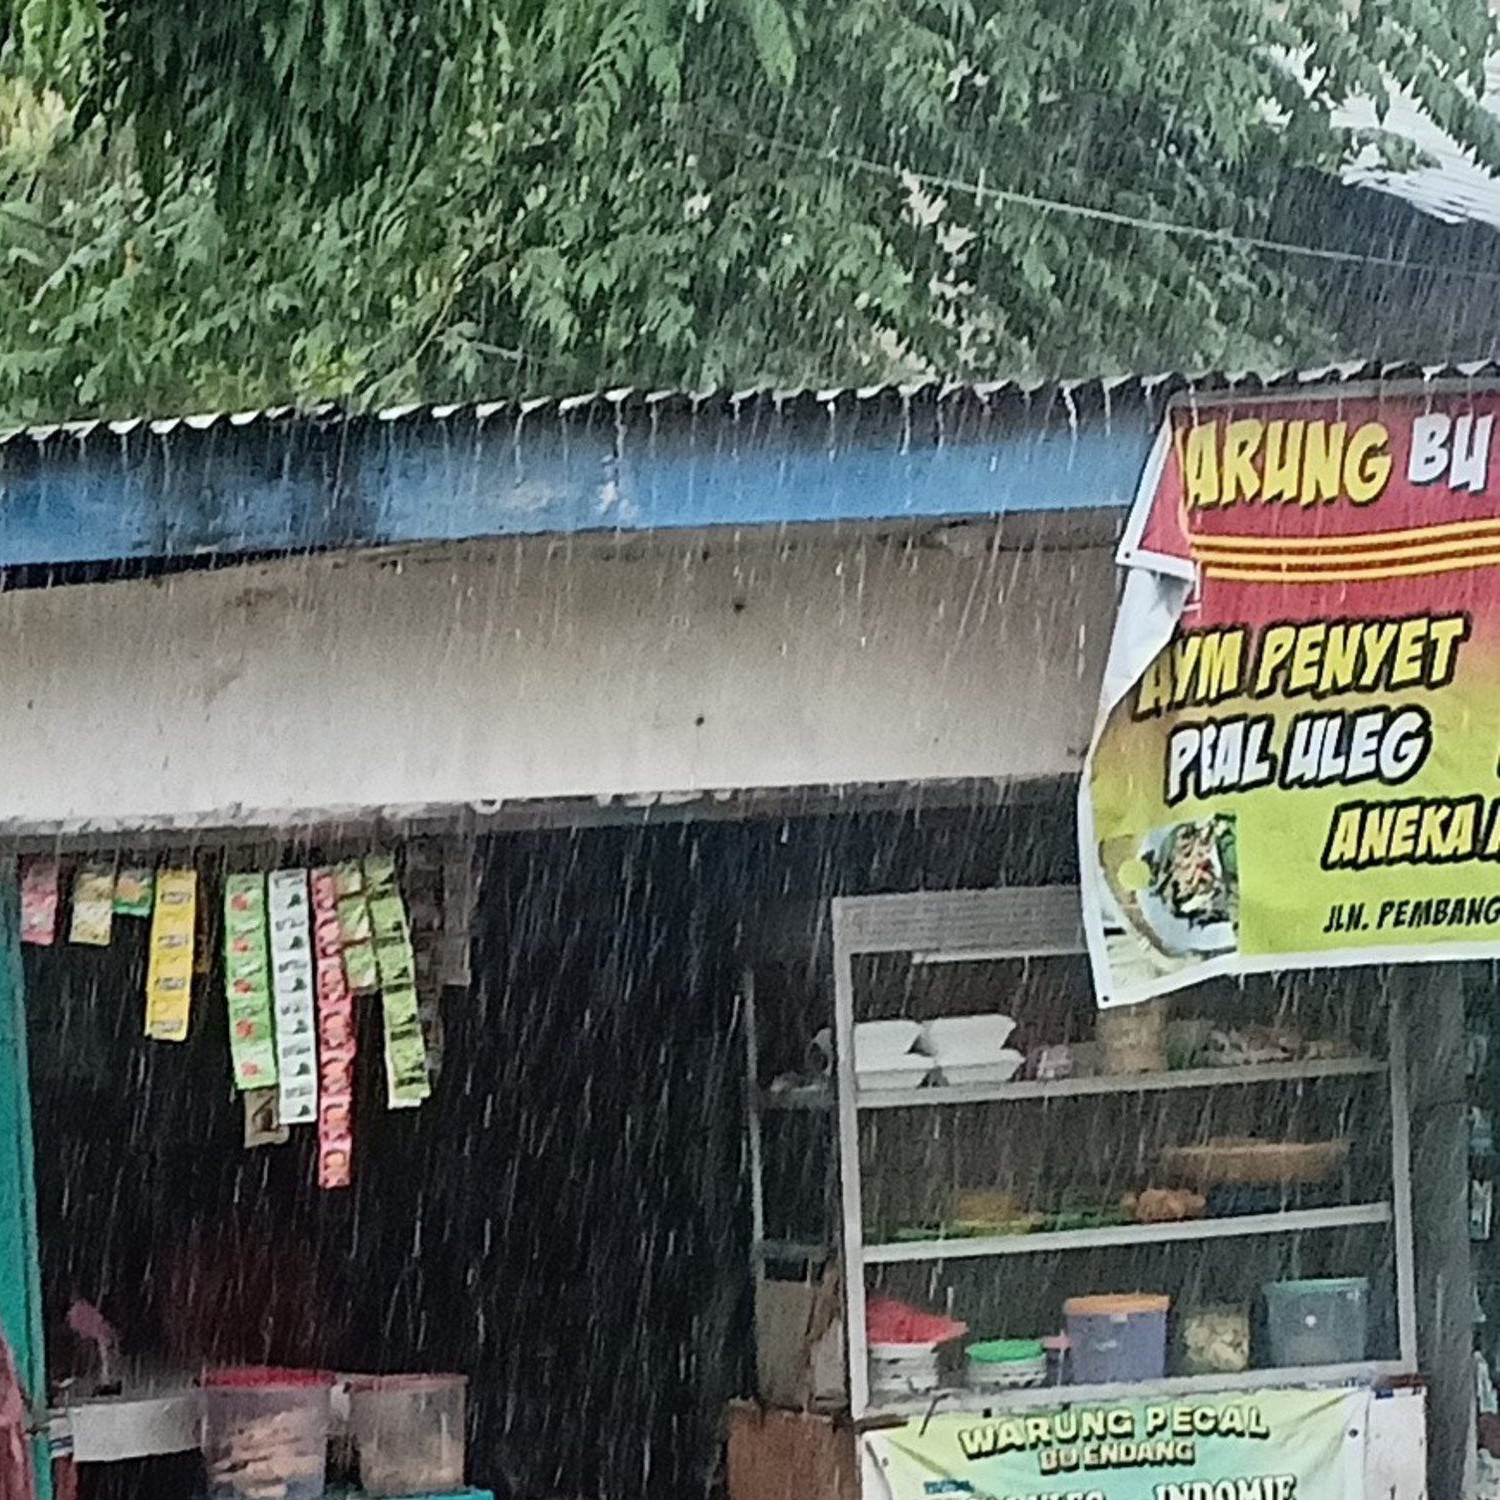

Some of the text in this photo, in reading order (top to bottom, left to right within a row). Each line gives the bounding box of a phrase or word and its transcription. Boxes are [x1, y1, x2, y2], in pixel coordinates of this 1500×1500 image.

[1174, 412, 1493, 510] ARUNG BU
[1254, 614, 1468, 700] PENYET
[1282, 709, 1430, 786] ULEG
[1325, 799, 1477, 870] ANEKA
[1323, 900, 1368, 933] JLN.
[959, 1404, 1271, 1461] WARUNG PECAL
[1039, 1440, 1197, 1476] BU ENDANG
